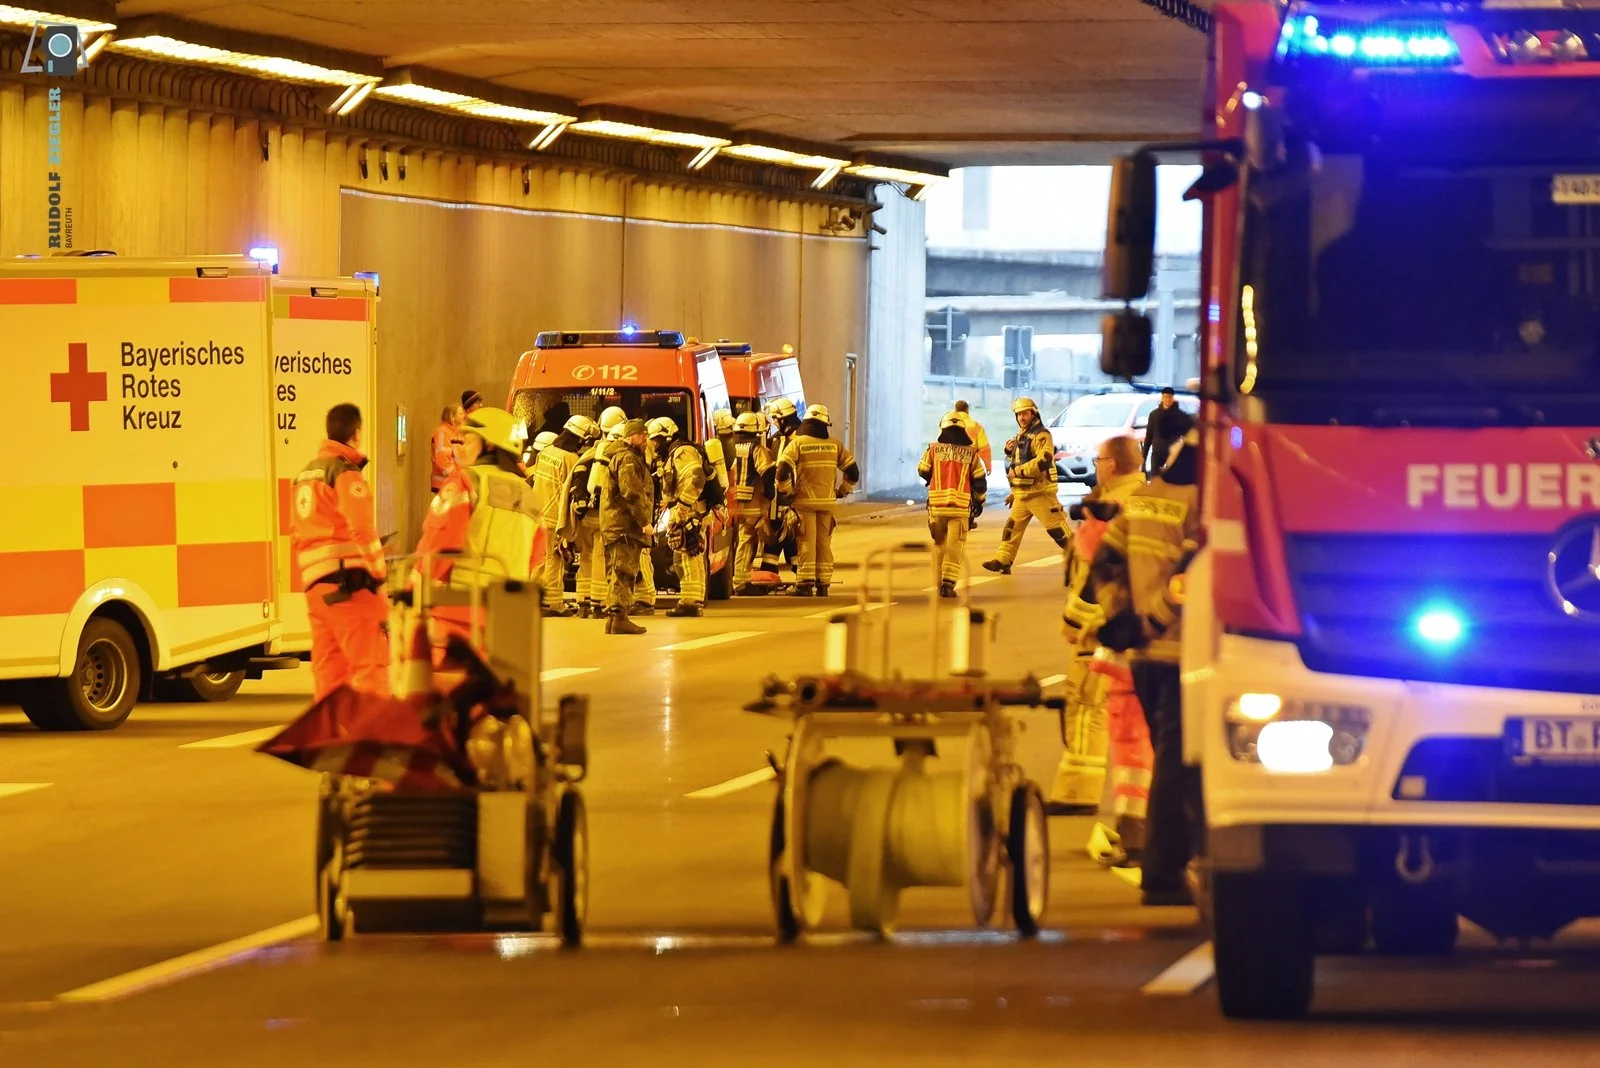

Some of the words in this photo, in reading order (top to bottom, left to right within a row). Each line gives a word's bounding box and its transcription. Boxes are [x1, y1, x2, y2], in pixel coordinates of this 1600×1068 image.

[121, 340, 245, 373] Bayerisches
[121, 373, 182, 399] Rotes
[598, 365, 638, 381] 112
[275, 384, 297, 402] es
[590, 387, 615, 396] 1/11/2
[122, 404, 182, 431] Kreuz
[1407, 463, 1600, 509] FEUER
[1534, 719, 1575, 751] BT
